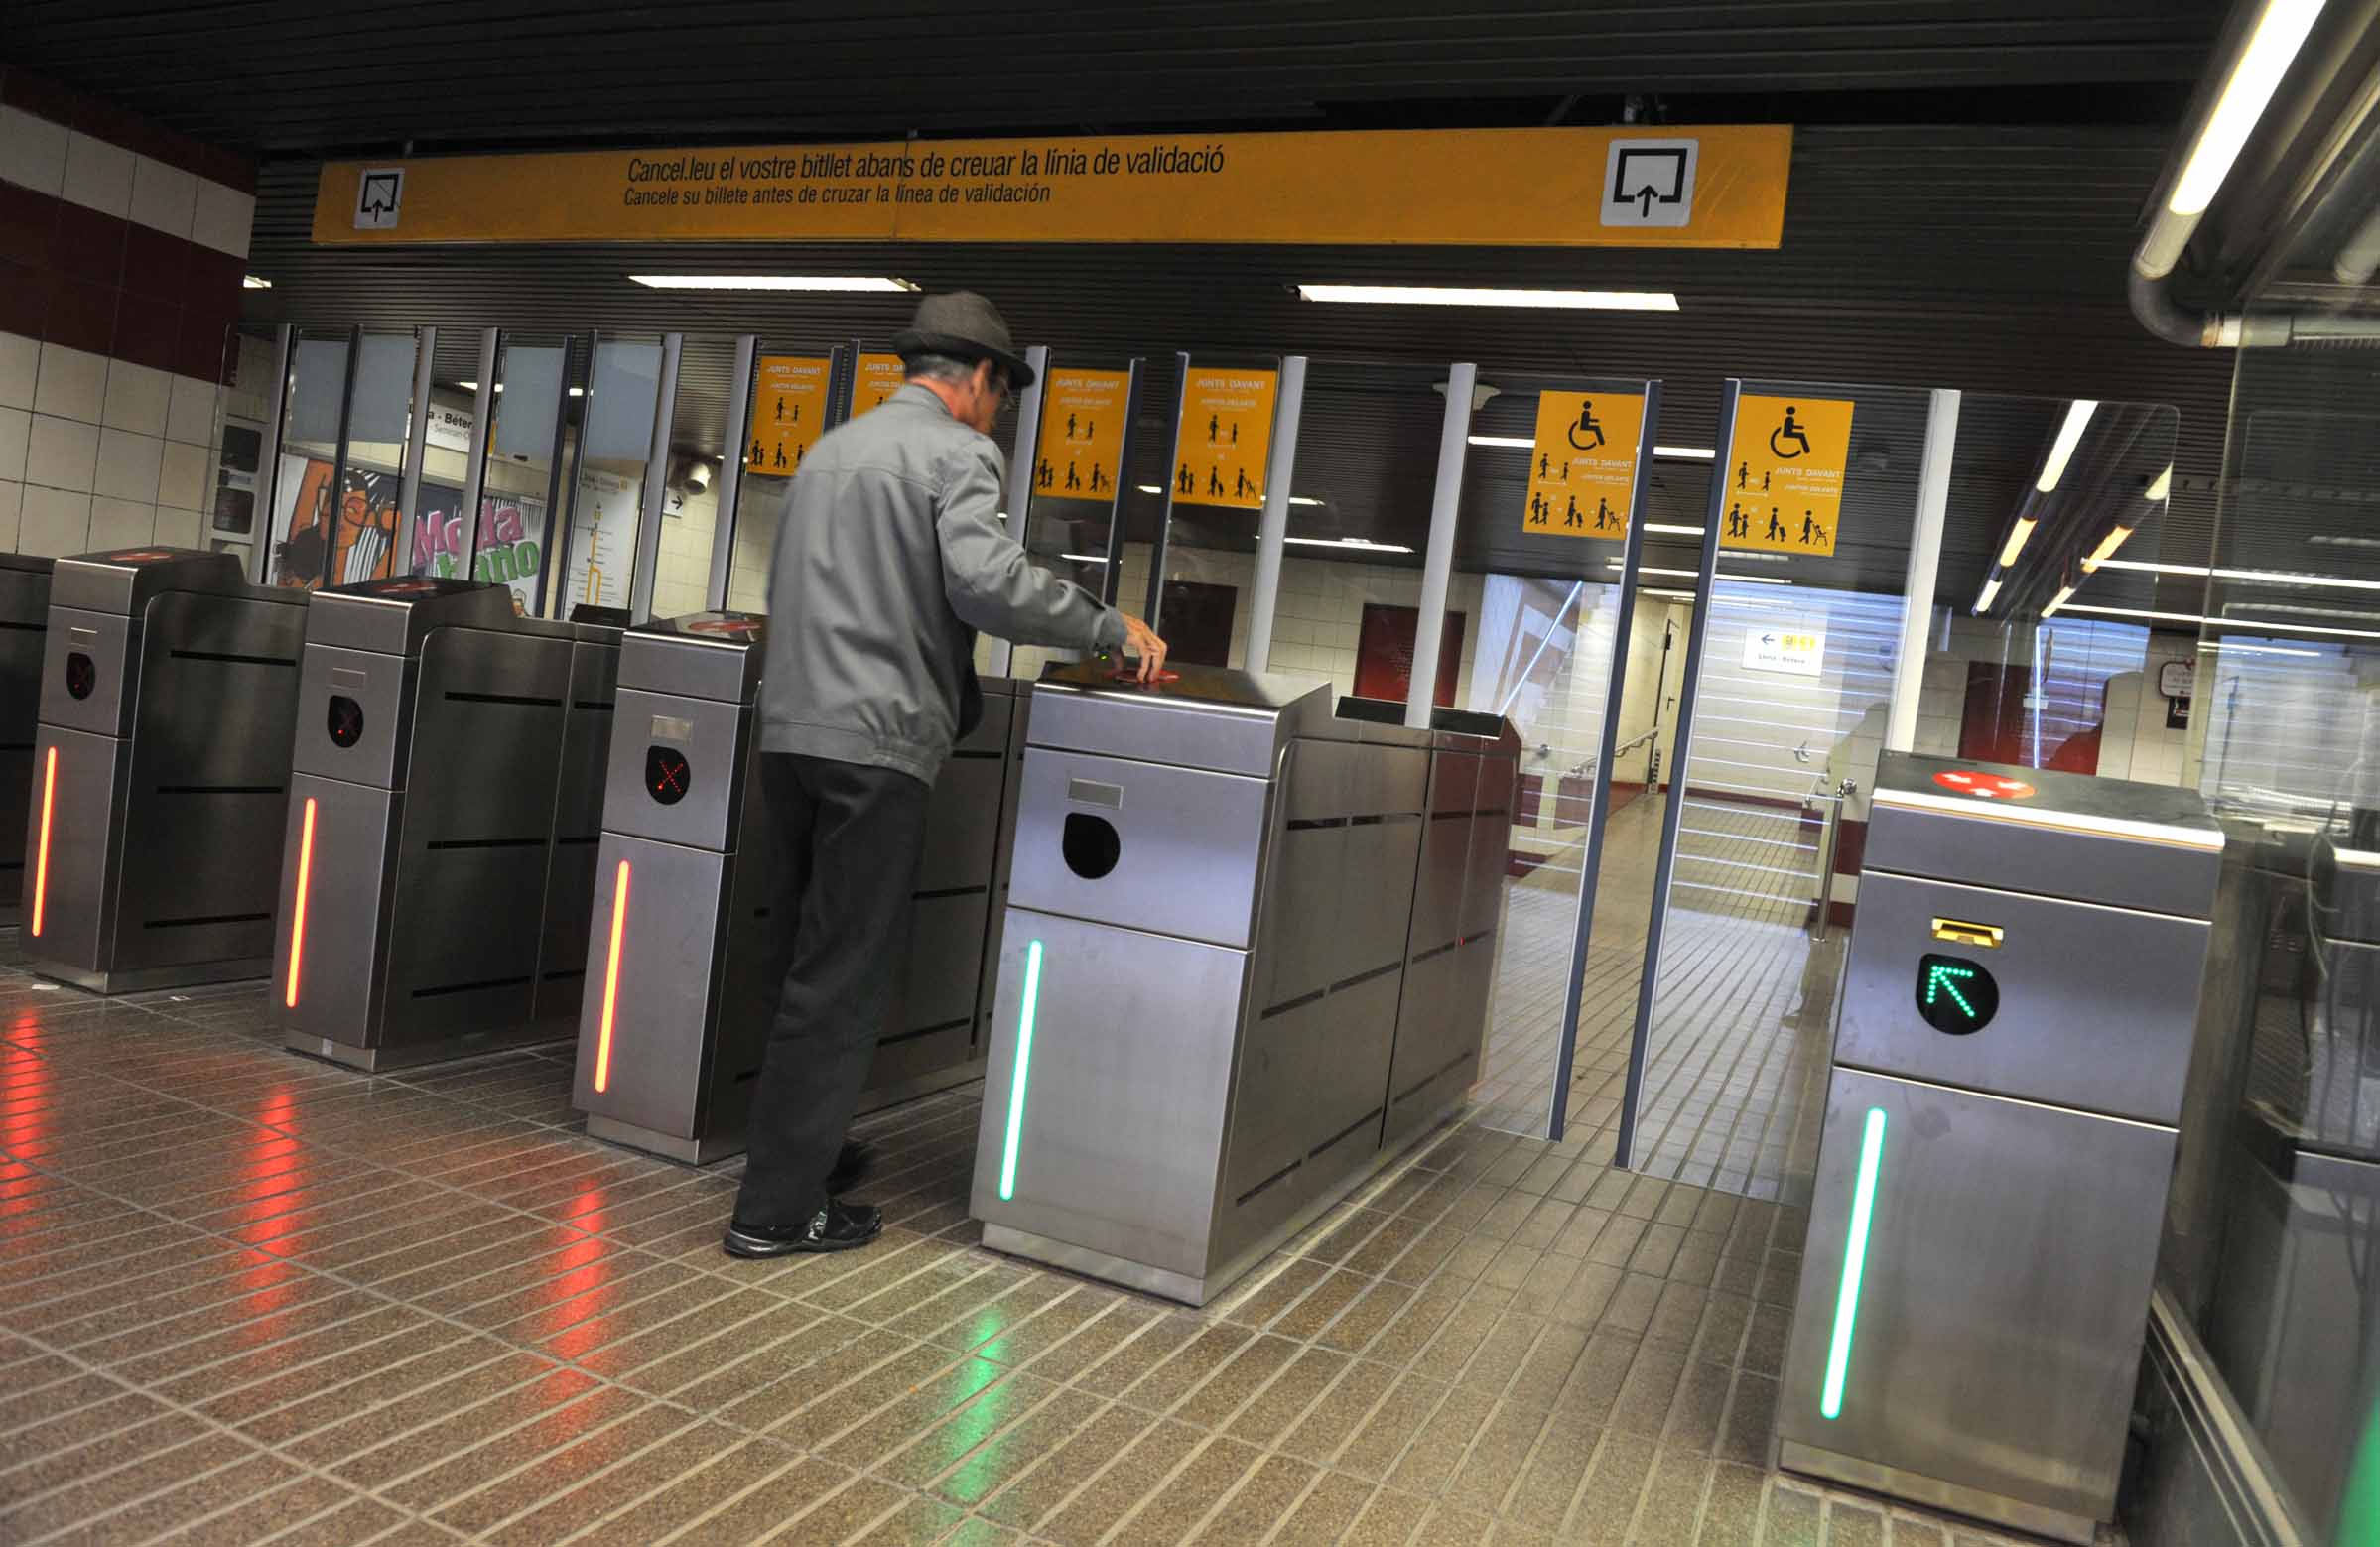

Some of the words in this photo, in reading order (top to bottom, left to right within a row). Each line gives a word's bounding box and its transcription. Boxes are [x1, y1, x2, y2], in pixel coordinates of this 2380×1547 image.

[719, 156, 736, 180] el
[739, 158, 795, 180] vostre
[801, 153, 851, 179] bitllet
[856, 153, 914, 179] abans
[920, 152, 944, 177] de
[950, 153, 1016, 177] creuar
[1021, 150, 1038, 176] la
[1044, 148, 1087, 176] línia
[1093, 148, 1121, 176] de
[1126, 144, 1224, 174] validació
[623, 186, 678, 206] Cancele
[682, 190, 700, 205] su
[704, 186, 749, 206] billete
[752, 187, 795, 204] antes
[799, 185, 818, 204] de
[822, 187, 872, 204] cruzar
[876, 183, 890, 203] la
[894, 184, 933, 203] línea
[938, 184, 959, 203] de
[964, 182, 1051, 204] validación
